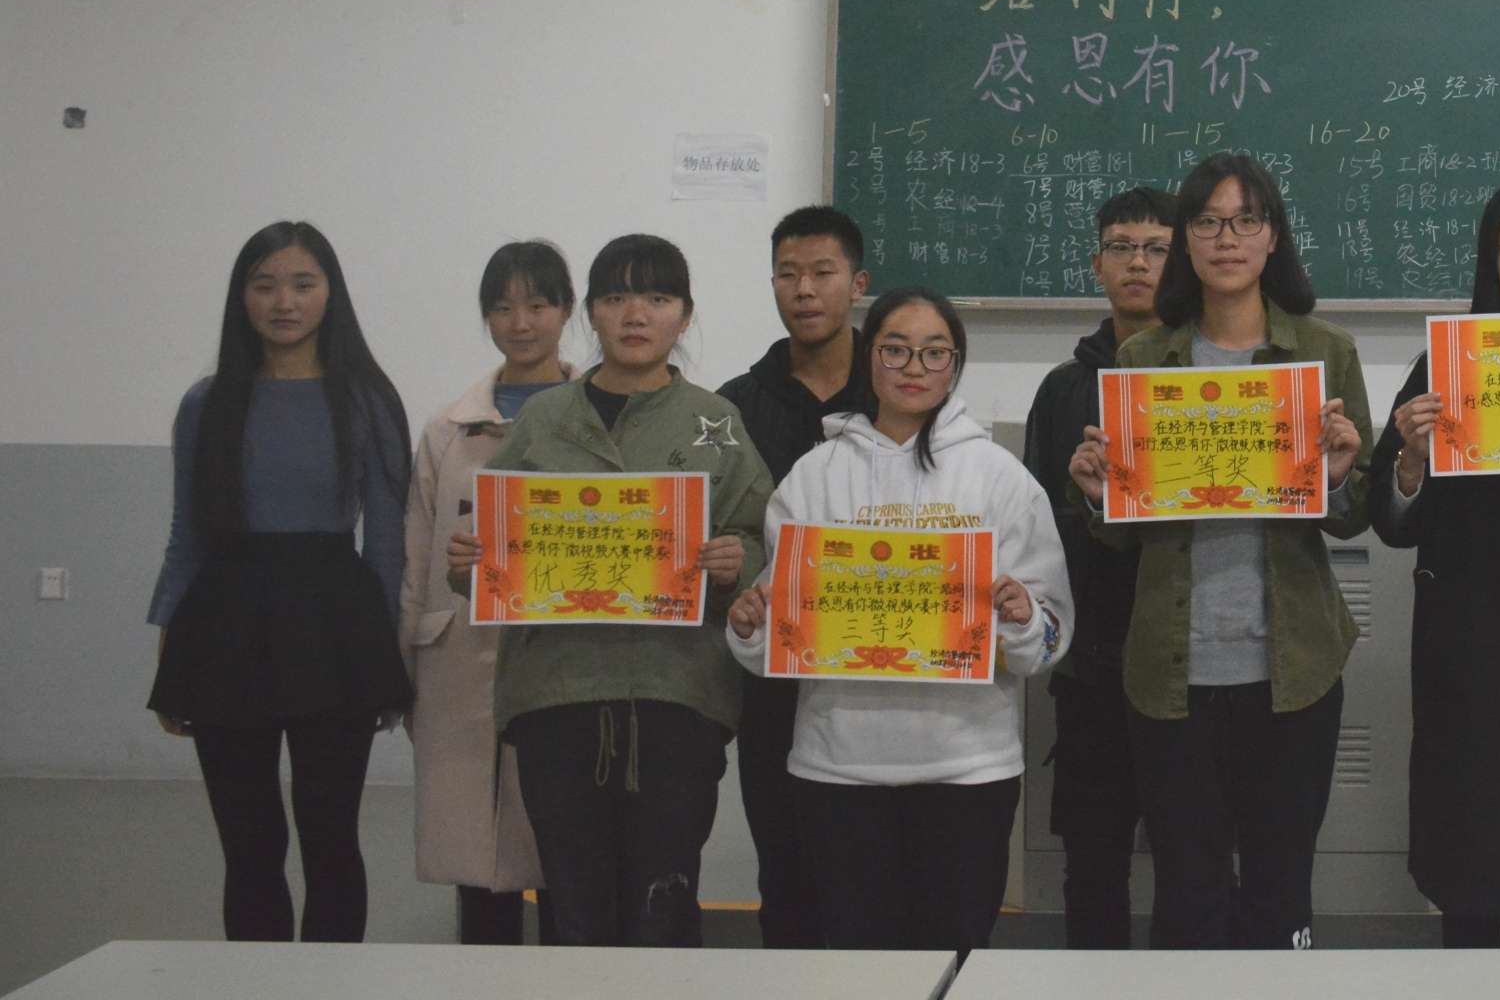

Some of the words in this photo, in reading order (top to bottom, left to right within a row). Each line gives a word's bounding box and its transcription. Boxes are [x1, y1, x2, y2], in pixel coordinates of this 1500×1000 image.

[973, 32, 1272, 112] 感恩有你
[1383, 77, 1427, 104] 20号
[1011, 123, 1058, 148] 6-10
[1309, 120, 1390, 144] 16-20
[846, 147, 884, 171] 2号
[905, 147, 1005, 175] 经济18-3
[1023, 152, 1048, 174] 6号
[1023, 176, 1052, 198] 7号
[1064, 177, 1139, 200] 财管18-
[1025, 200, 1053, 228] 8号
[1155, 454, 1257, 487] 二等奖
[529, 560, 633, 593] 优秀奖
[841, 614, 915, 645] 三等奖
